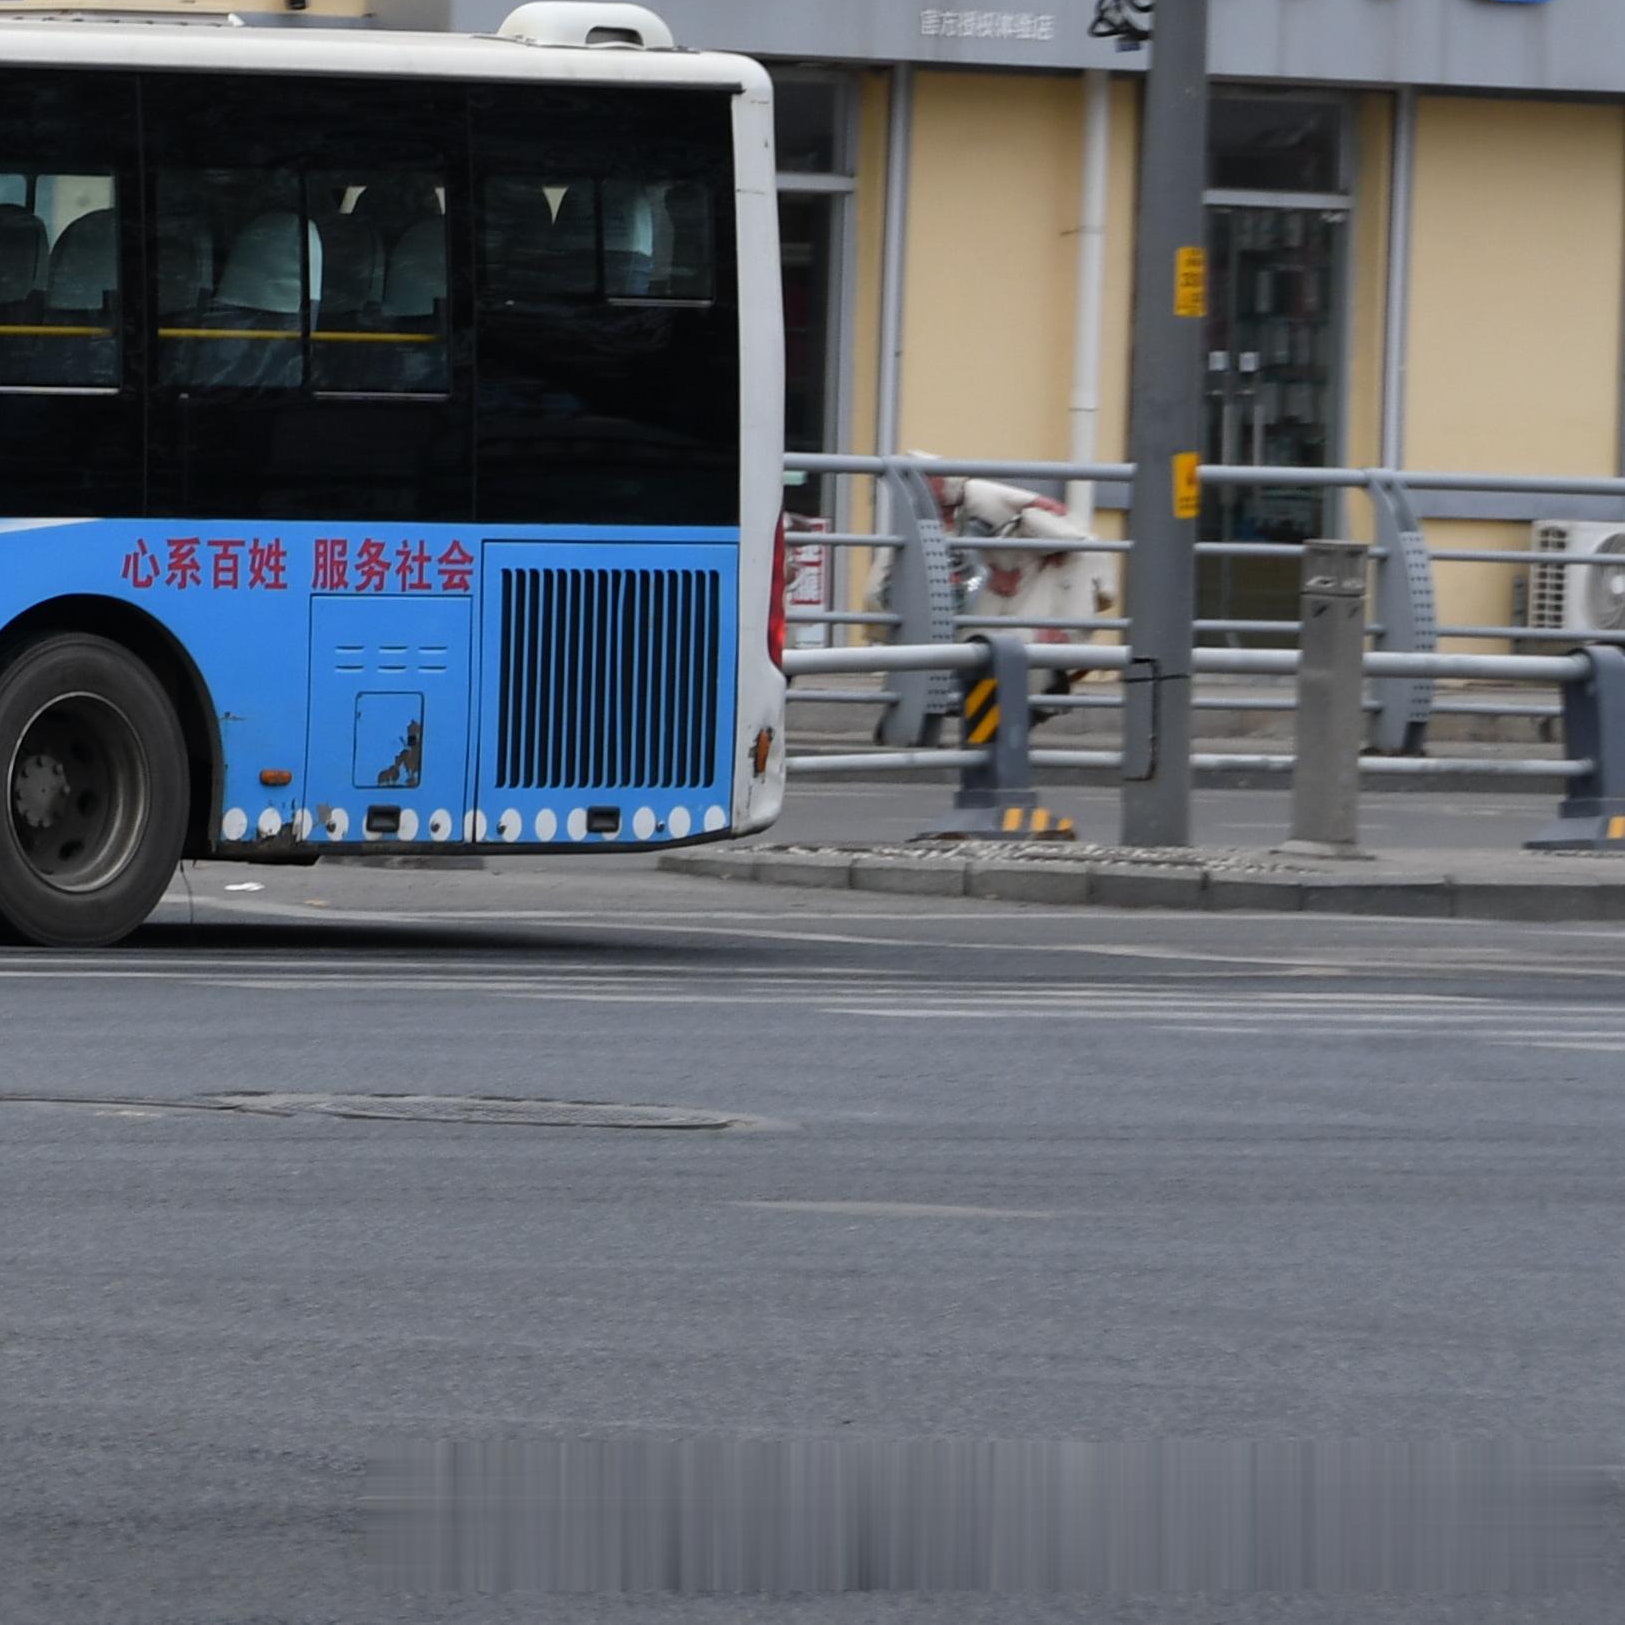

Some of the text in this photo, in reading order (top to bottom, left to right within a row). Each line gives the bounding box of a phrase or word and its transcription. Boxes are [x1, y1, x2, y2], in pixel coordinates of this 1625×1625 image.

[120, 537, 476, 593] 心系百姓 服务社会
